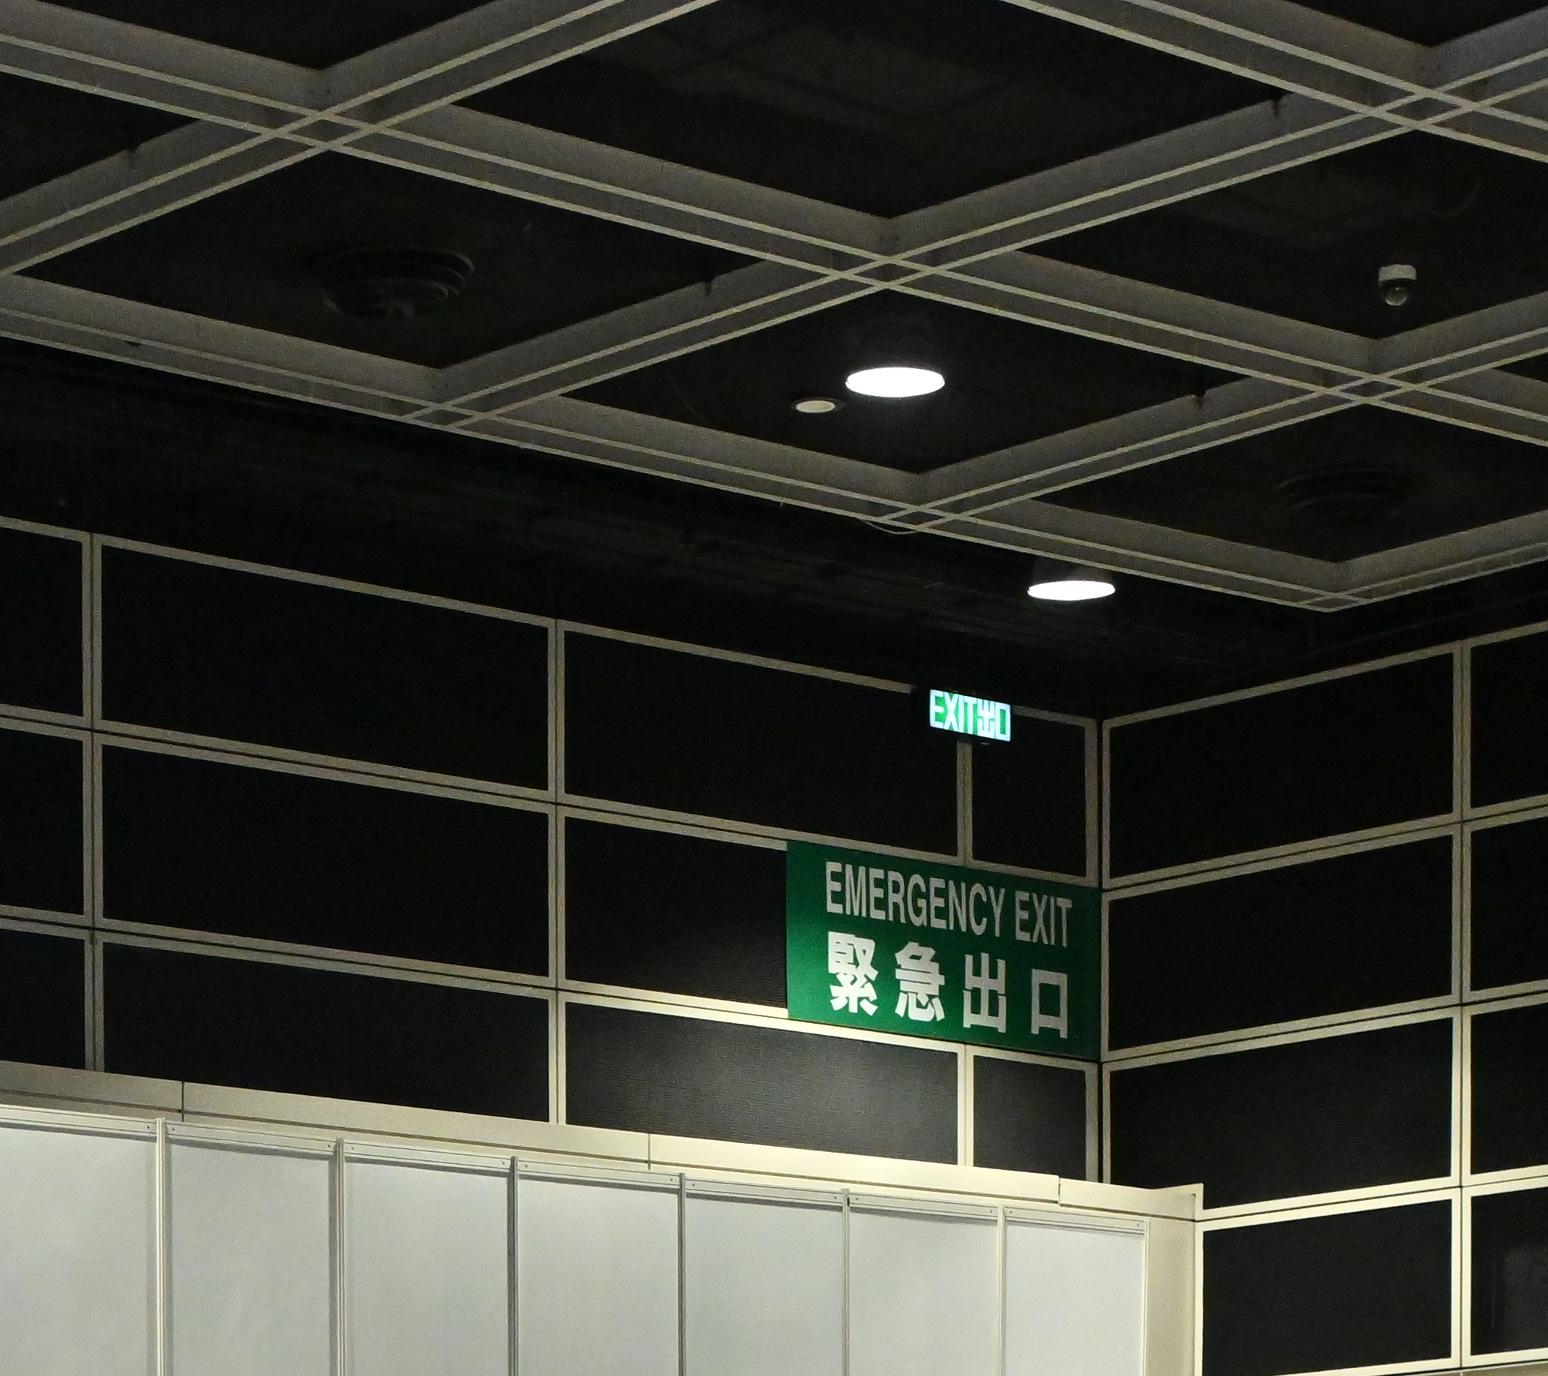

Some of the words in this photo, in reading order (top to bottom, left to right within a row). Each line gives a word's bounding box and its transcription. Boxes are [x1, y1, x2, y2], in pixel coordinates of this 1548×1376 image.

[930, 690, 978, 735] EXIT
[825, 861, 1005, 938] EMERGENCY
[1015, 890, 1072, 947] EXIT
[828, 931, 1068, 1039] 緊急出口
